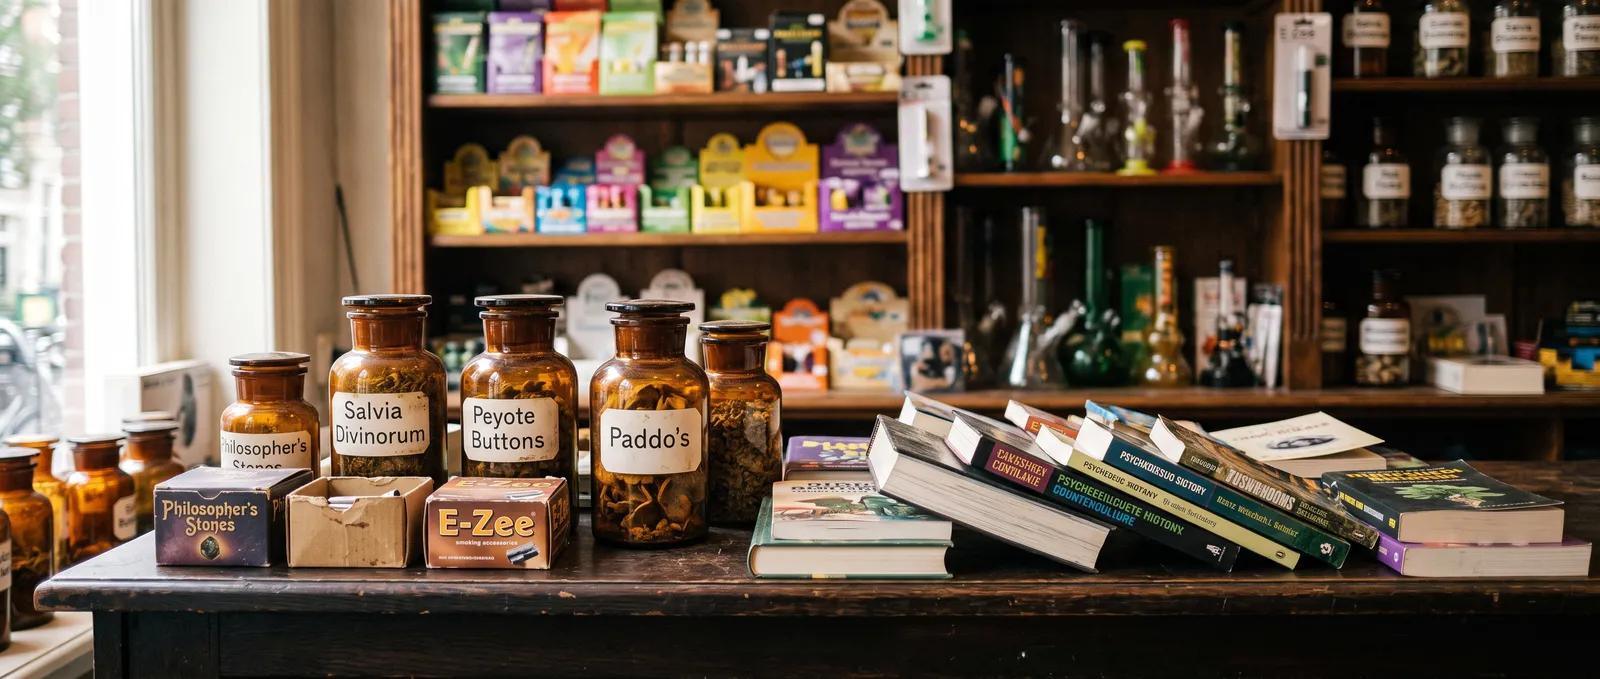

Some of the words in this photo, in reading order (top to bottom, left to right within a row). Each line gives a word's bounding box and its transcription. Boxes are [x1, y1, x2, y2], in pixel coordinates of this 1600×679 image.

[344, 400, 403, 420] Salvia
[473, 405, 536, 429] Peyote
[336, 424, 425, 445] Divinorum
[472, 431, 545, 450] Buttons
[610, 426, 690, 449] Paddo's
[161, 498, 259, 521] Philosopher's
[185, 516, 236, 536] Stones
[438, 508, 535, 537] E-Zee
